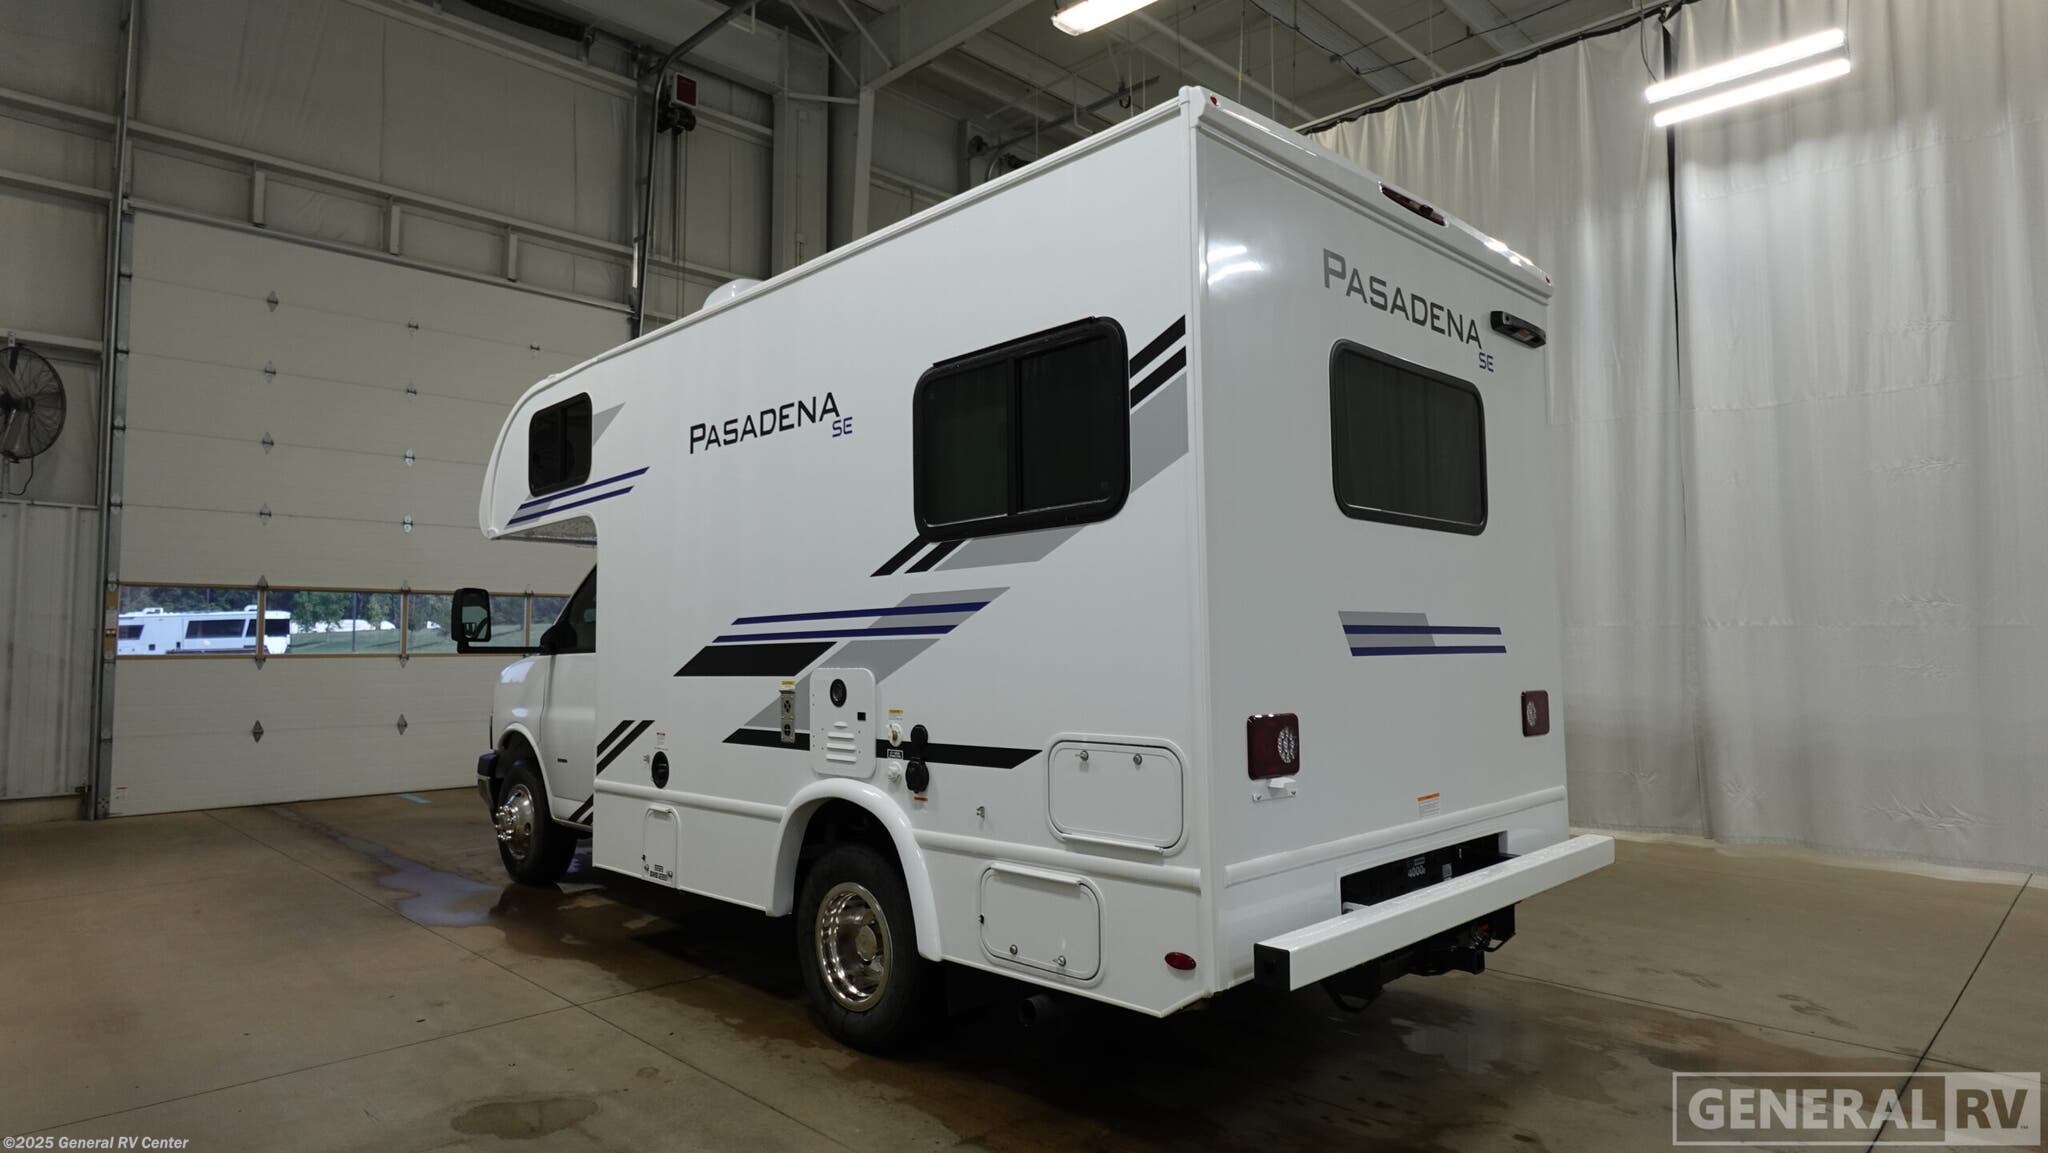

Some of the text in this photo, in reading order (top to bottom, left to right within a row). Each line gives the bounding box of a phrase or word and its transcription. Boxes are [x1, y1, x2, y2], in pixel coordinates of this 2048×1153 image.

[1323, 248, 1482, 349] PASADENA
[1478, 352, 1494, 372] SE
[690, 392, 840, 454] PASADENA
[832, 416, 853, 438] SE
